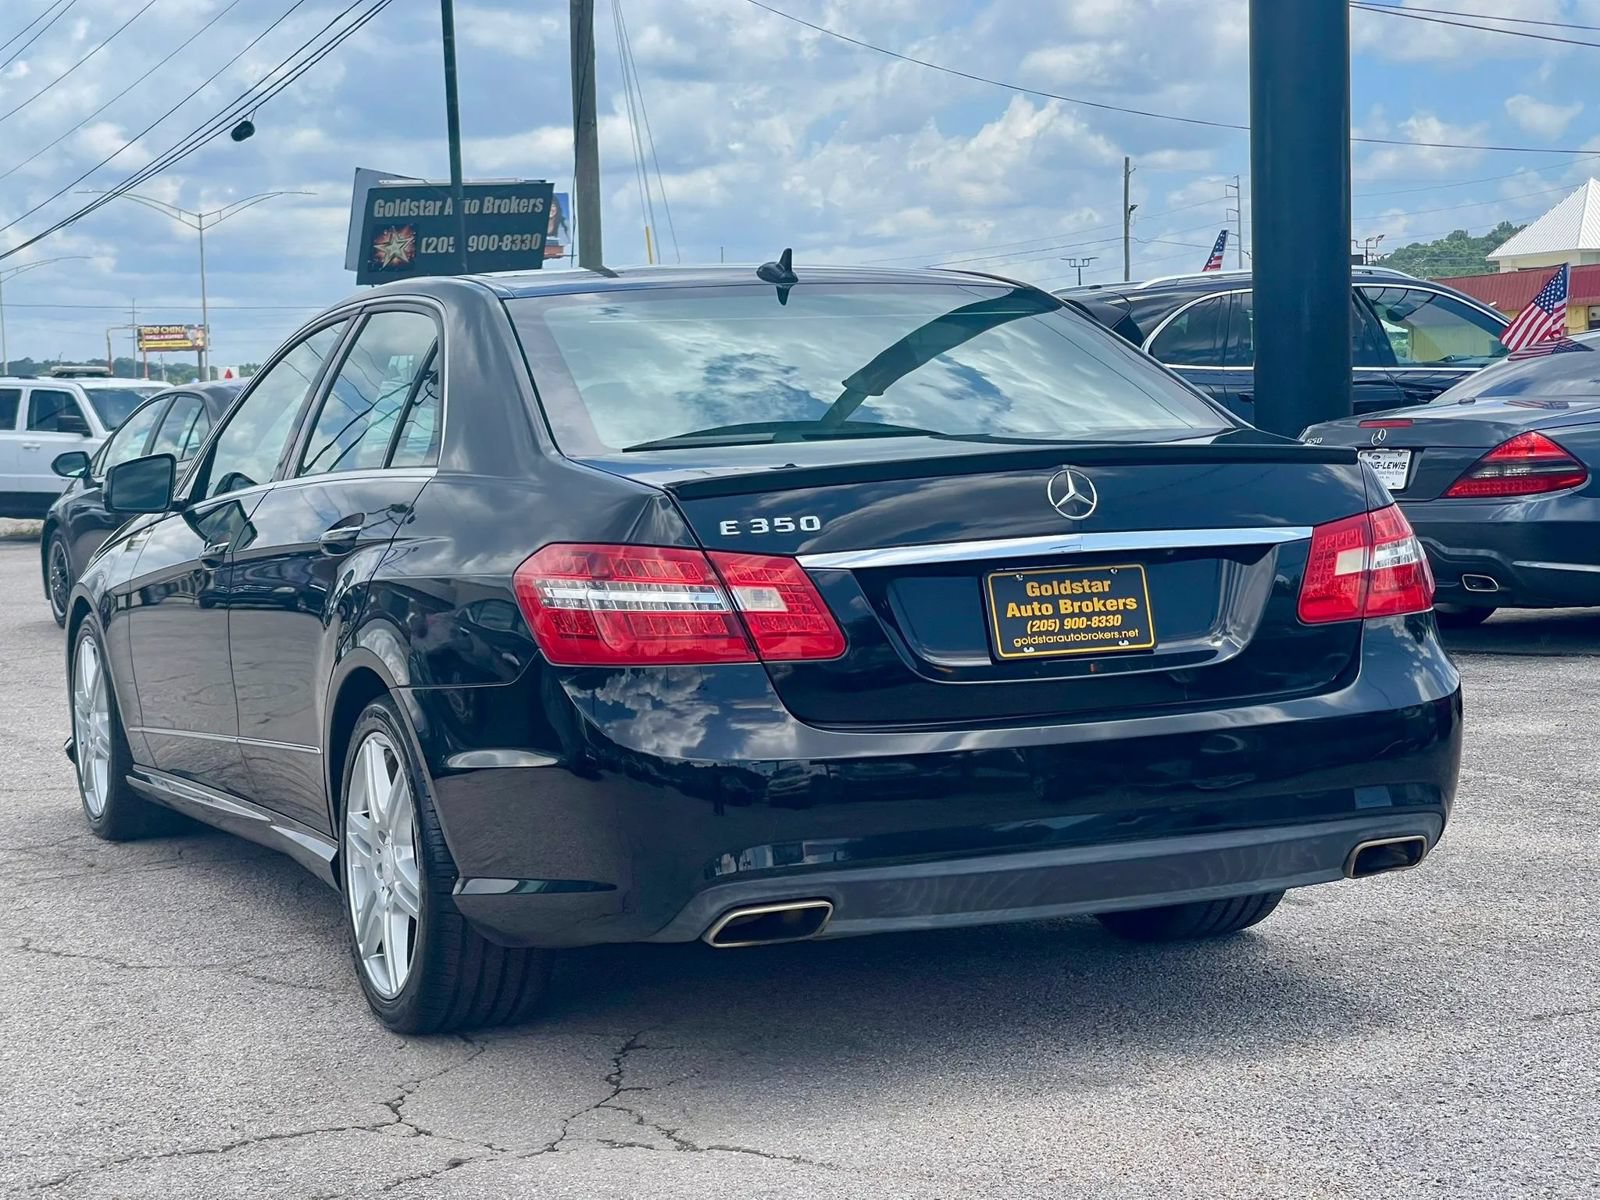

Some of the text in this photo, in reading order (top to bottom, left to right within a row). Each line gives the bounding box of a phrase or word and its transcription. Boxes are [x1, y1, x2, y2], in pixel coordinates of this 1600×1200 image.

[374, 195, 544, 218] Goldstar Ato Brokers
[467, 233, 541, 252] 900-8330
[719, 515, 821, 536] E 350
[1025, 579, 1111, 597] Goldstar
[1006, 597, 1138, 618] Auto Brokers
[1026, 614, 1122, 635] (205) 900-8330
[1013, 628, 1140, 647] goldstarautobrokers.net
